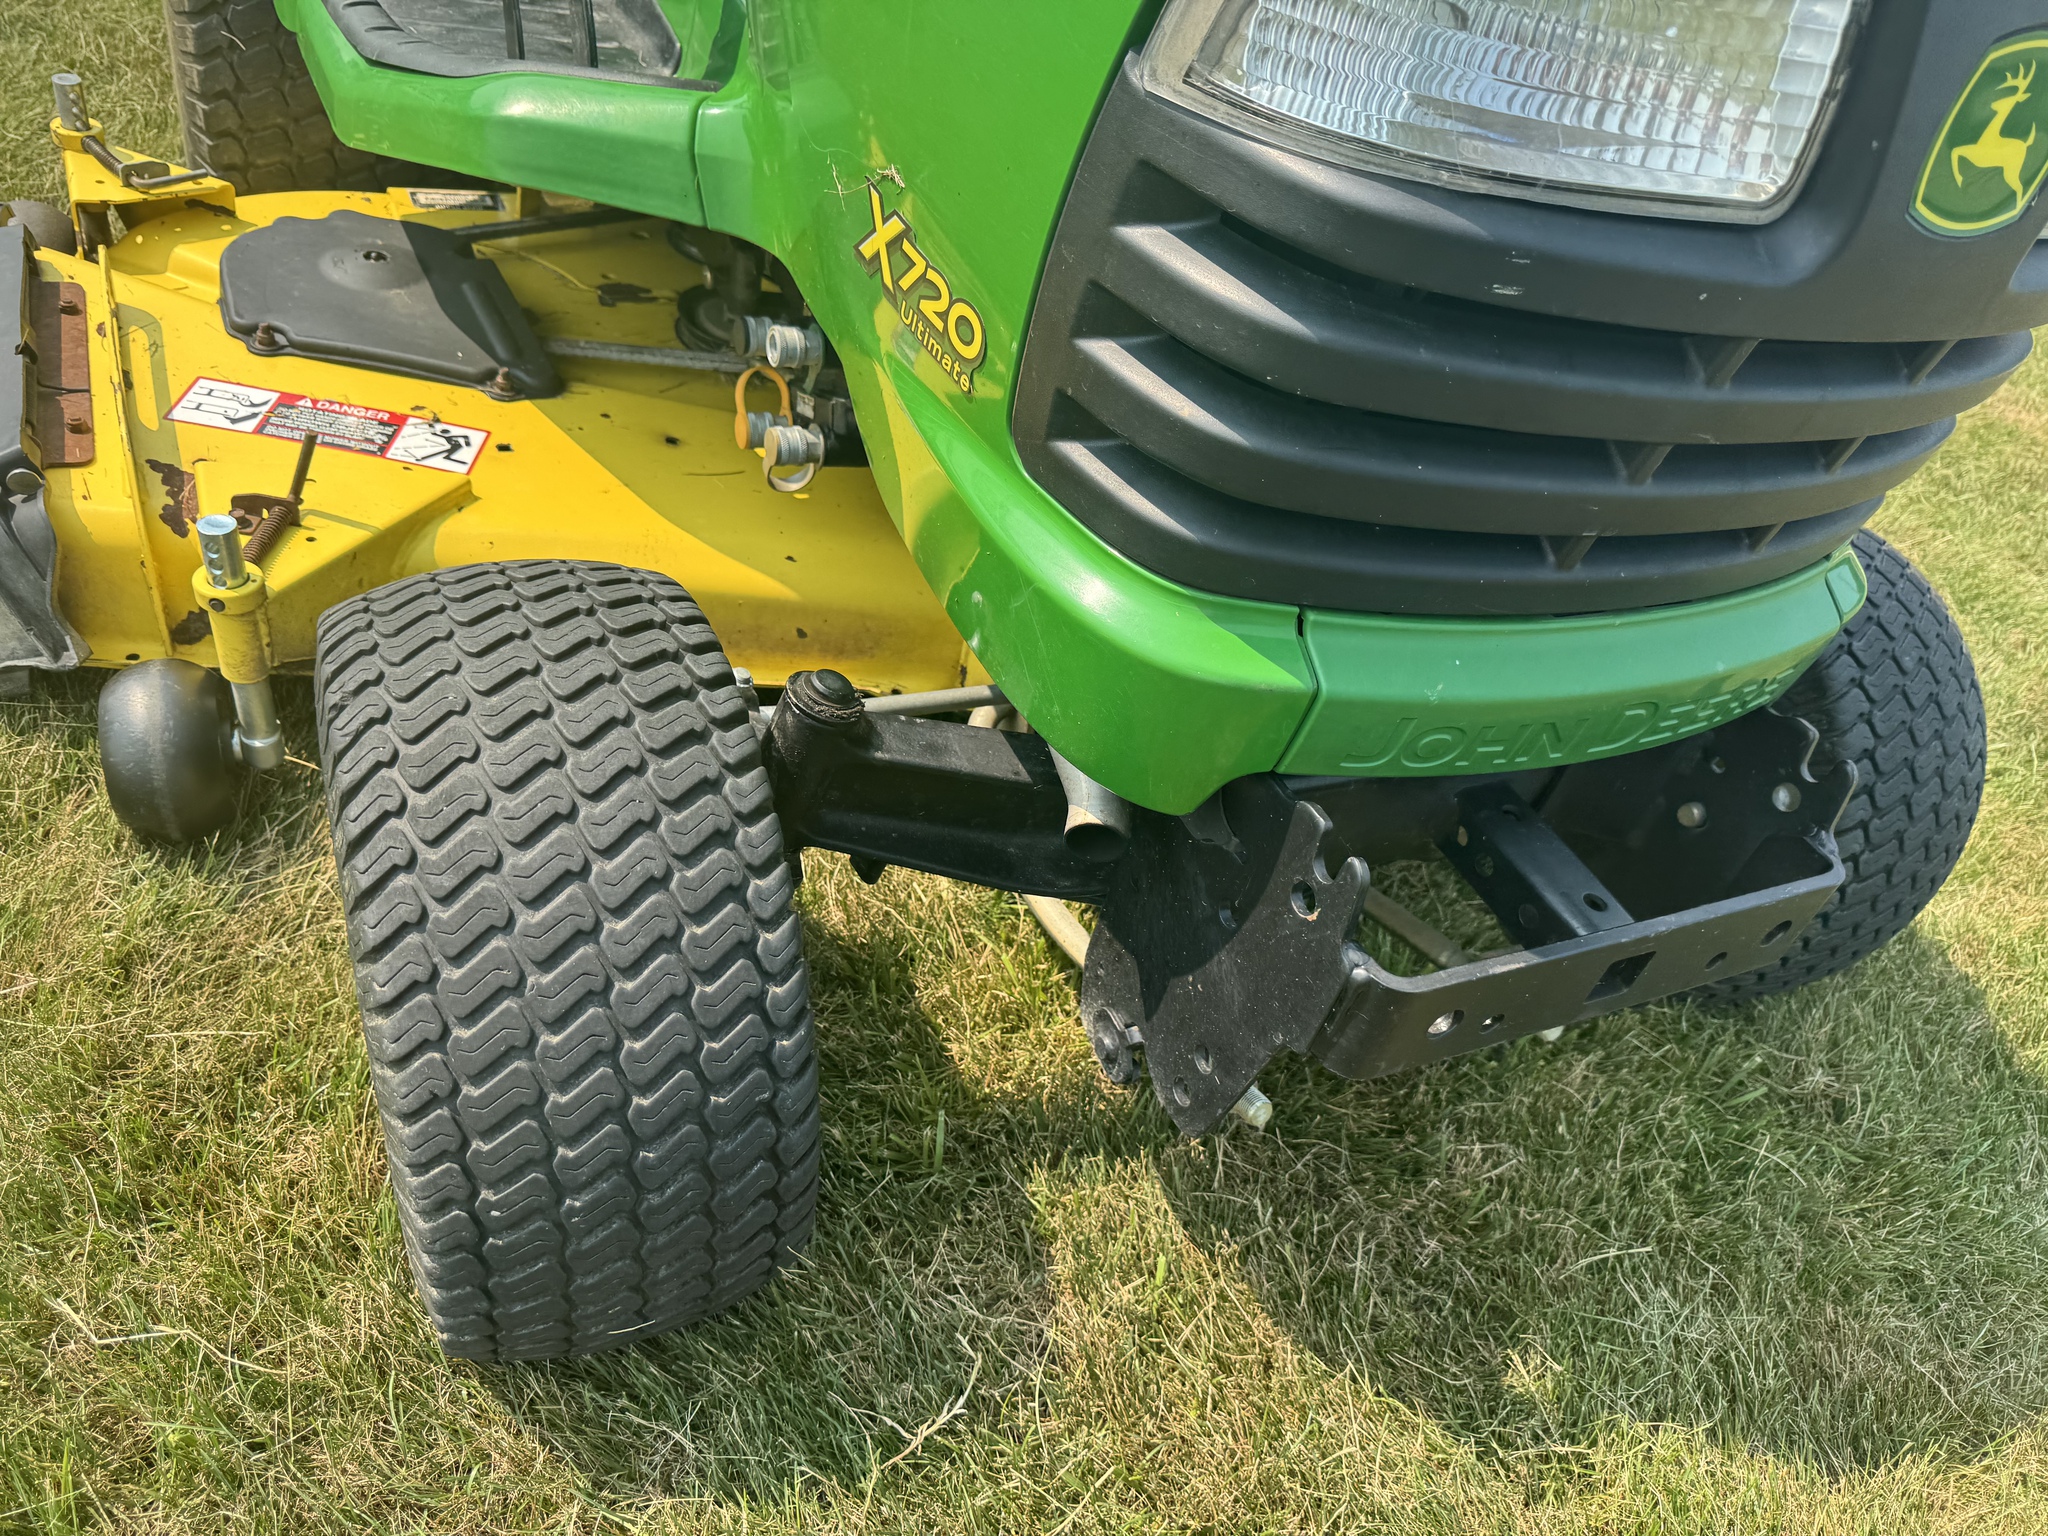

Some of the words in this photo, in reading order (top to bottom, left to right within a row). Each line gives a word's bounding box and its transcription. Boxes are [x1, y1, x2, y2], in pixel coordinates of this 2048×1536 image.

[858, 182, 984, 361] X720
[899, 300, 971, 394] Ultimate
[316, 401, 391, 421] DANGER
[1340, 716, 1590, 768] JOHN
[1587, 666, 1797, 754] DEERE
